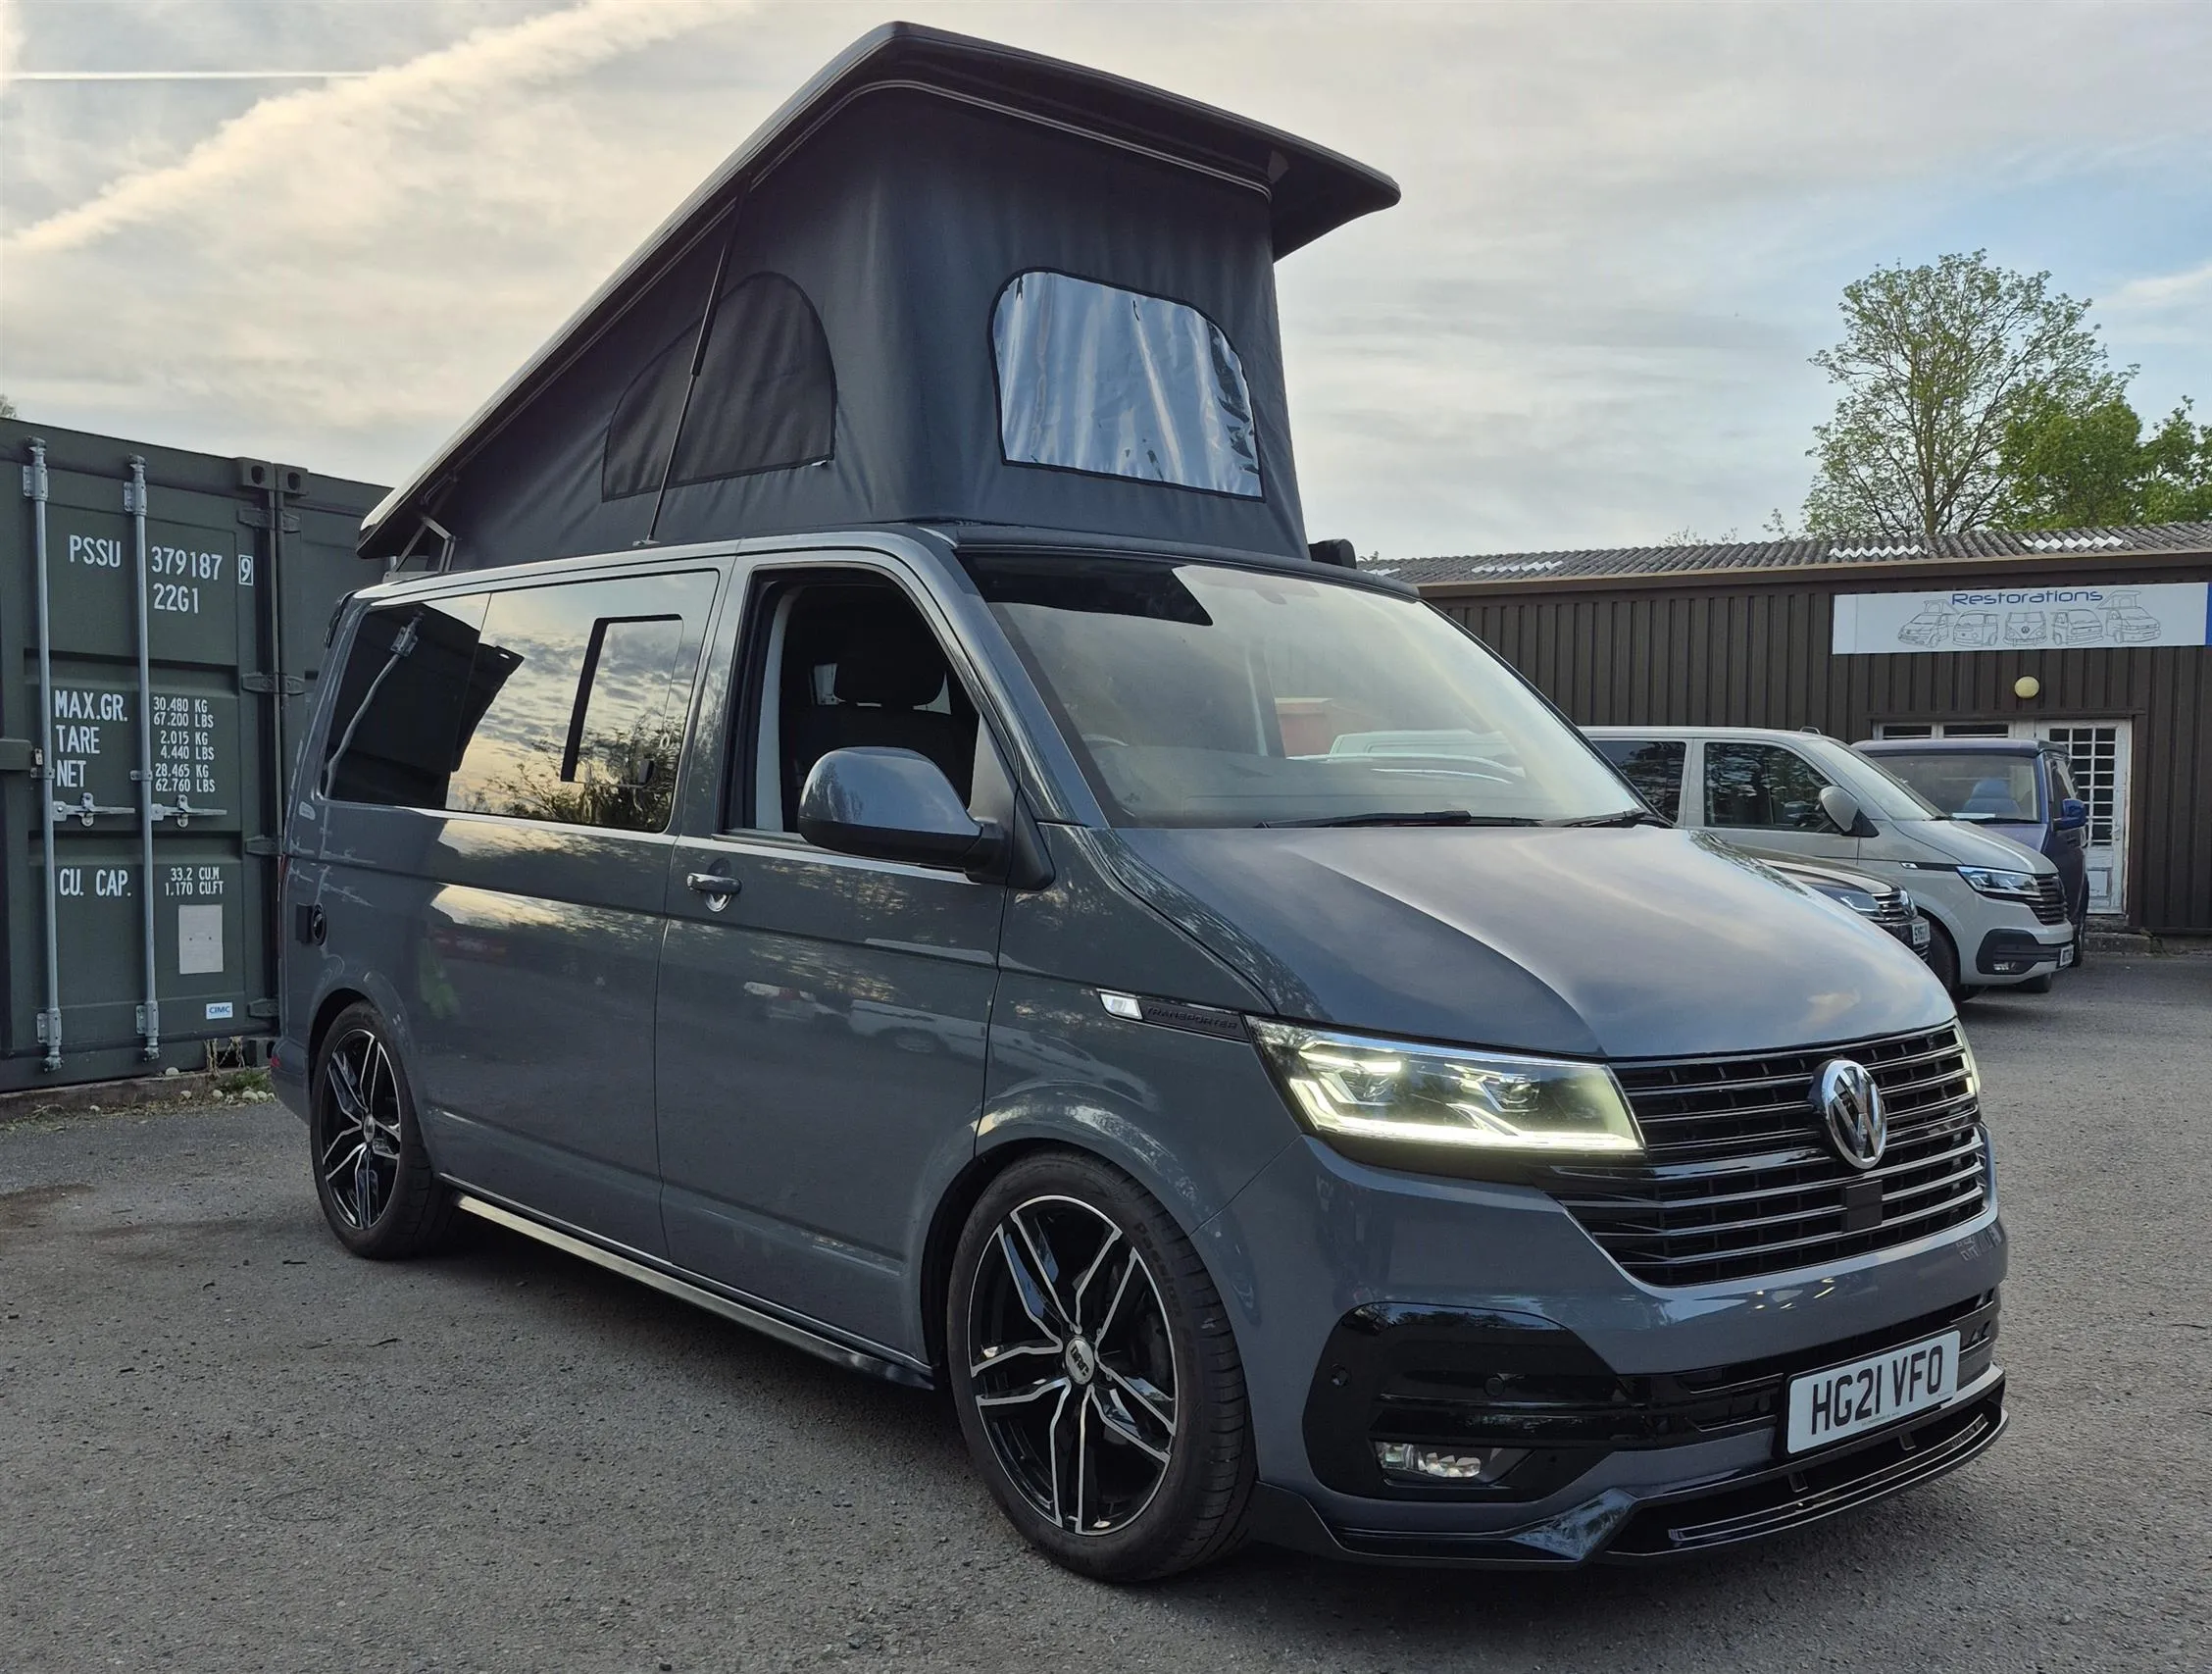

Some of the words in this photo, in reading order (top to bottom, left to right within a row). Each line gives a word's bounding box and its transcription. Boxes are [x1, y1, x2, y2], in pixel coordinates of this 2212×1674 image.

[69, 534, 121, 568] PSSU
[151, 546, 223, 581] 379187
[240, 557, 252, 583] 9
[153, 583, 199, 614] 22G1
[1951, 589, 2103, 606] Restorations
[153, 696, 189, 712] 30.480
[195, 699, 208, 712] KG
[153, 711, 189, 727] 67.200
[195, 714, 214, 728] LBS
[56, 725, 101, 754] TARE
[160, 730, 189, 745] 2.015
[195, 732, 209, 745] KG
[160, 745, 189, 760] 4.440
[195, 746, 215, 760] LBS
[56, 760, 87, 787] NET
[155, 763, 190, 778] 28.465
[196, 764, 209, 778] KG
[155, 778, 191, 792] 62.760
[196, 779, 215, 792] LBS
[59, 869, 84, 896] CU.
[95, 870, 132, 896] CAP.
[171, 867, 193, 882] 33.2
[165, 882, 193, 895] 1.170
[209, 1005, 230, 1014] CIMC
[1811, 1364, 1883, 1436] HG21
[1892, 1344, 1943, 1407] VFO
